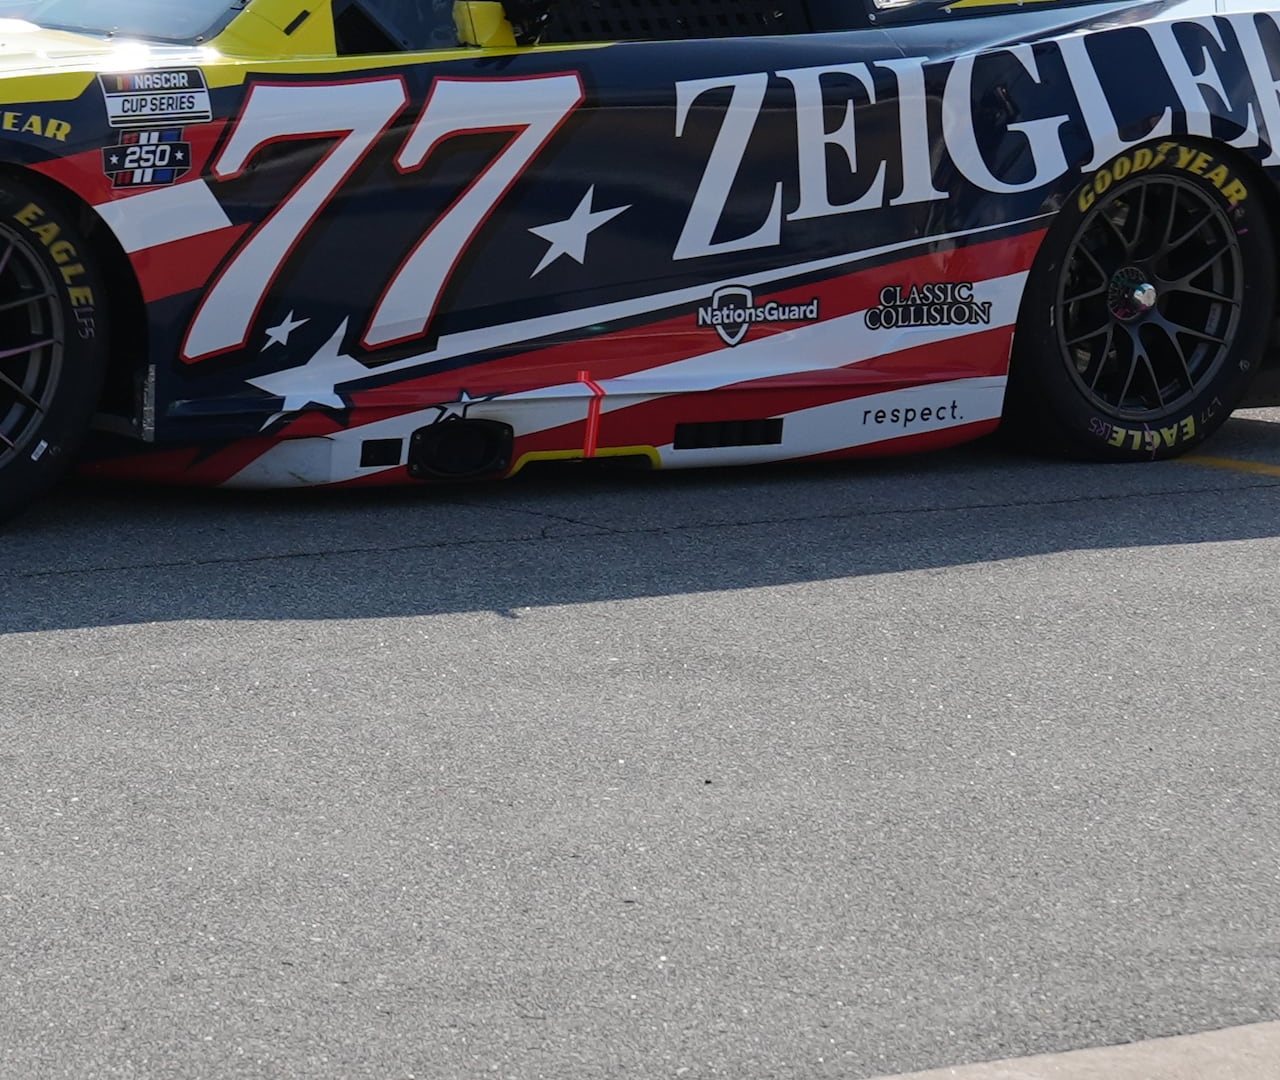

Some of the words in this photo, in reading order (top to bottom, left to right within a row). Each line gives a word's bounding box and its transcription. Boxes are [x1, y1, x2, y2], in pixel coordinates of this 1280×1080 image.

[135, 72, 189, 89] NASCAR
[122, 98, 147, 113] CUP
[150, 95, 195, 112] SERIES
[124, 144, 171, 169] 250
[179, 70, 586, 364] 77
[14, 202, 95, 306] EAGLE
[879, 283, 974, 308] CLASSIC
[698, 299, 818, 326] NationsGuard
[865, 302, 992, 330] COLLISION
[863, 400, 965, 427] respect.
[1107, 414, 1196, 451] EAGLE
